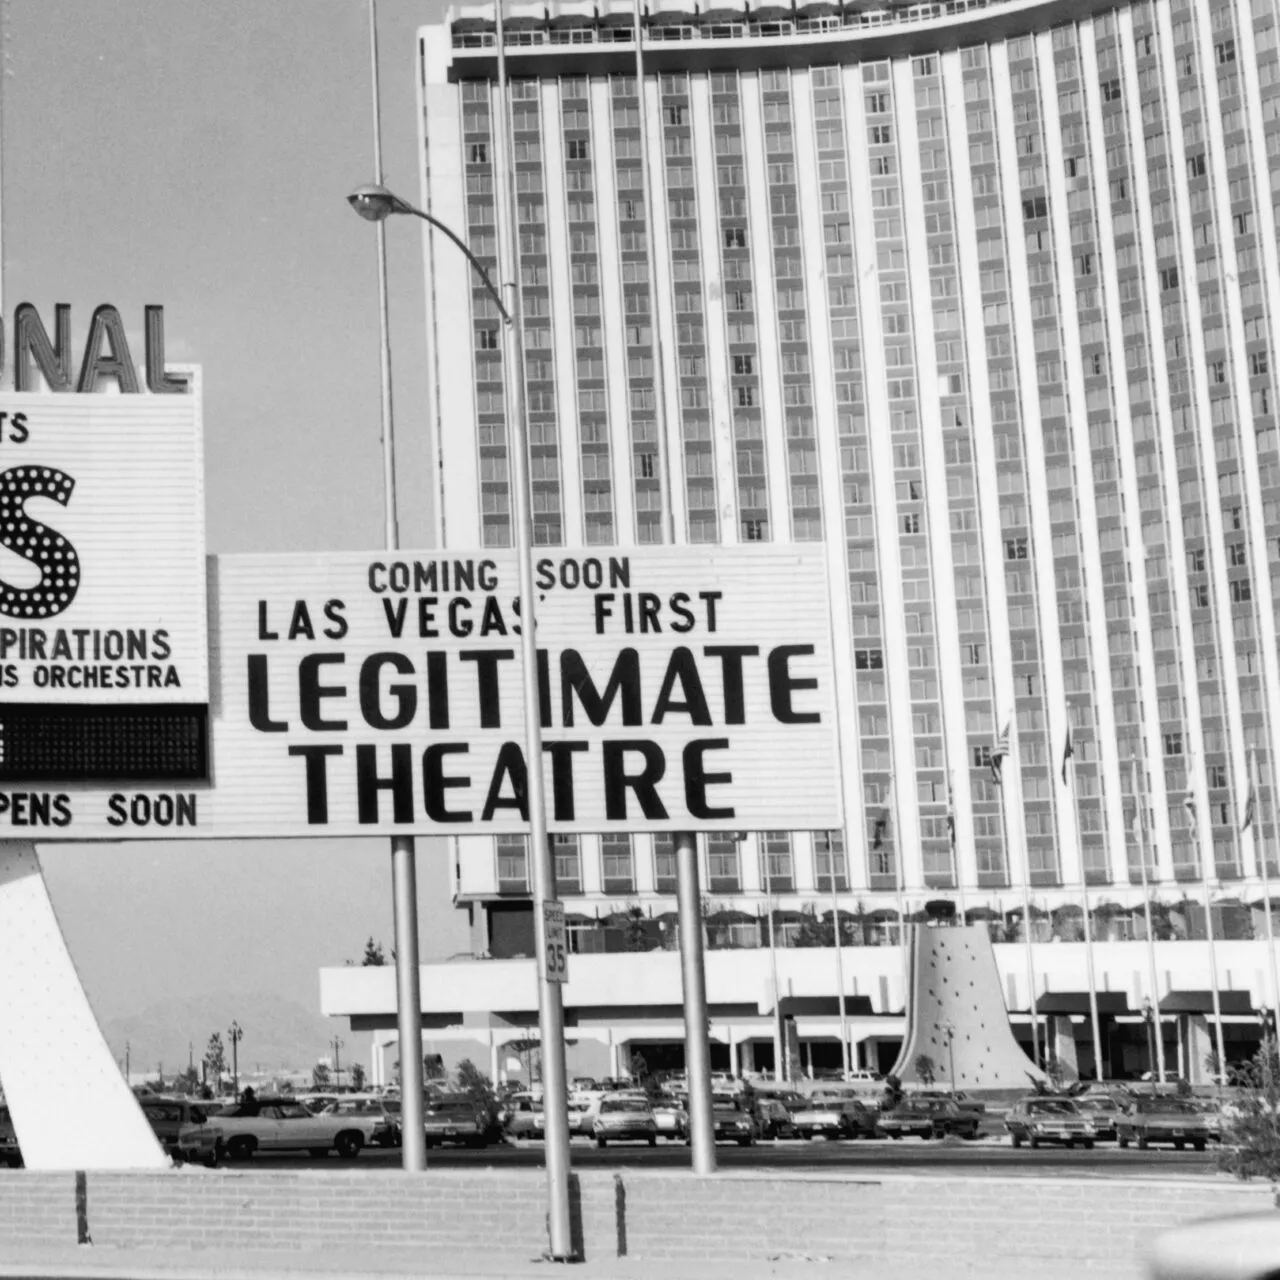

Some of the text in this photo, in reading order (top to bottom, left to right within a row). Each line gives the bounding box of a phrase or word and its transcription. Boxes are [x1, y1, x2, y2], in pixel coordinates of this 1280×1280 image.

[368, 557, 631, 593] COMING SOON
[257, 600, 349, 641] LAS
[594, 591, 723, 635] FIRST
[33, 665, 181, 689] ORCHESTRA
[246, 643, 822, 733] LEGITIMATE
[287, 737, 736, 825] THEATRE
[107, 794, 198, 827] SOON
[547, 943, 565, 973] 35
